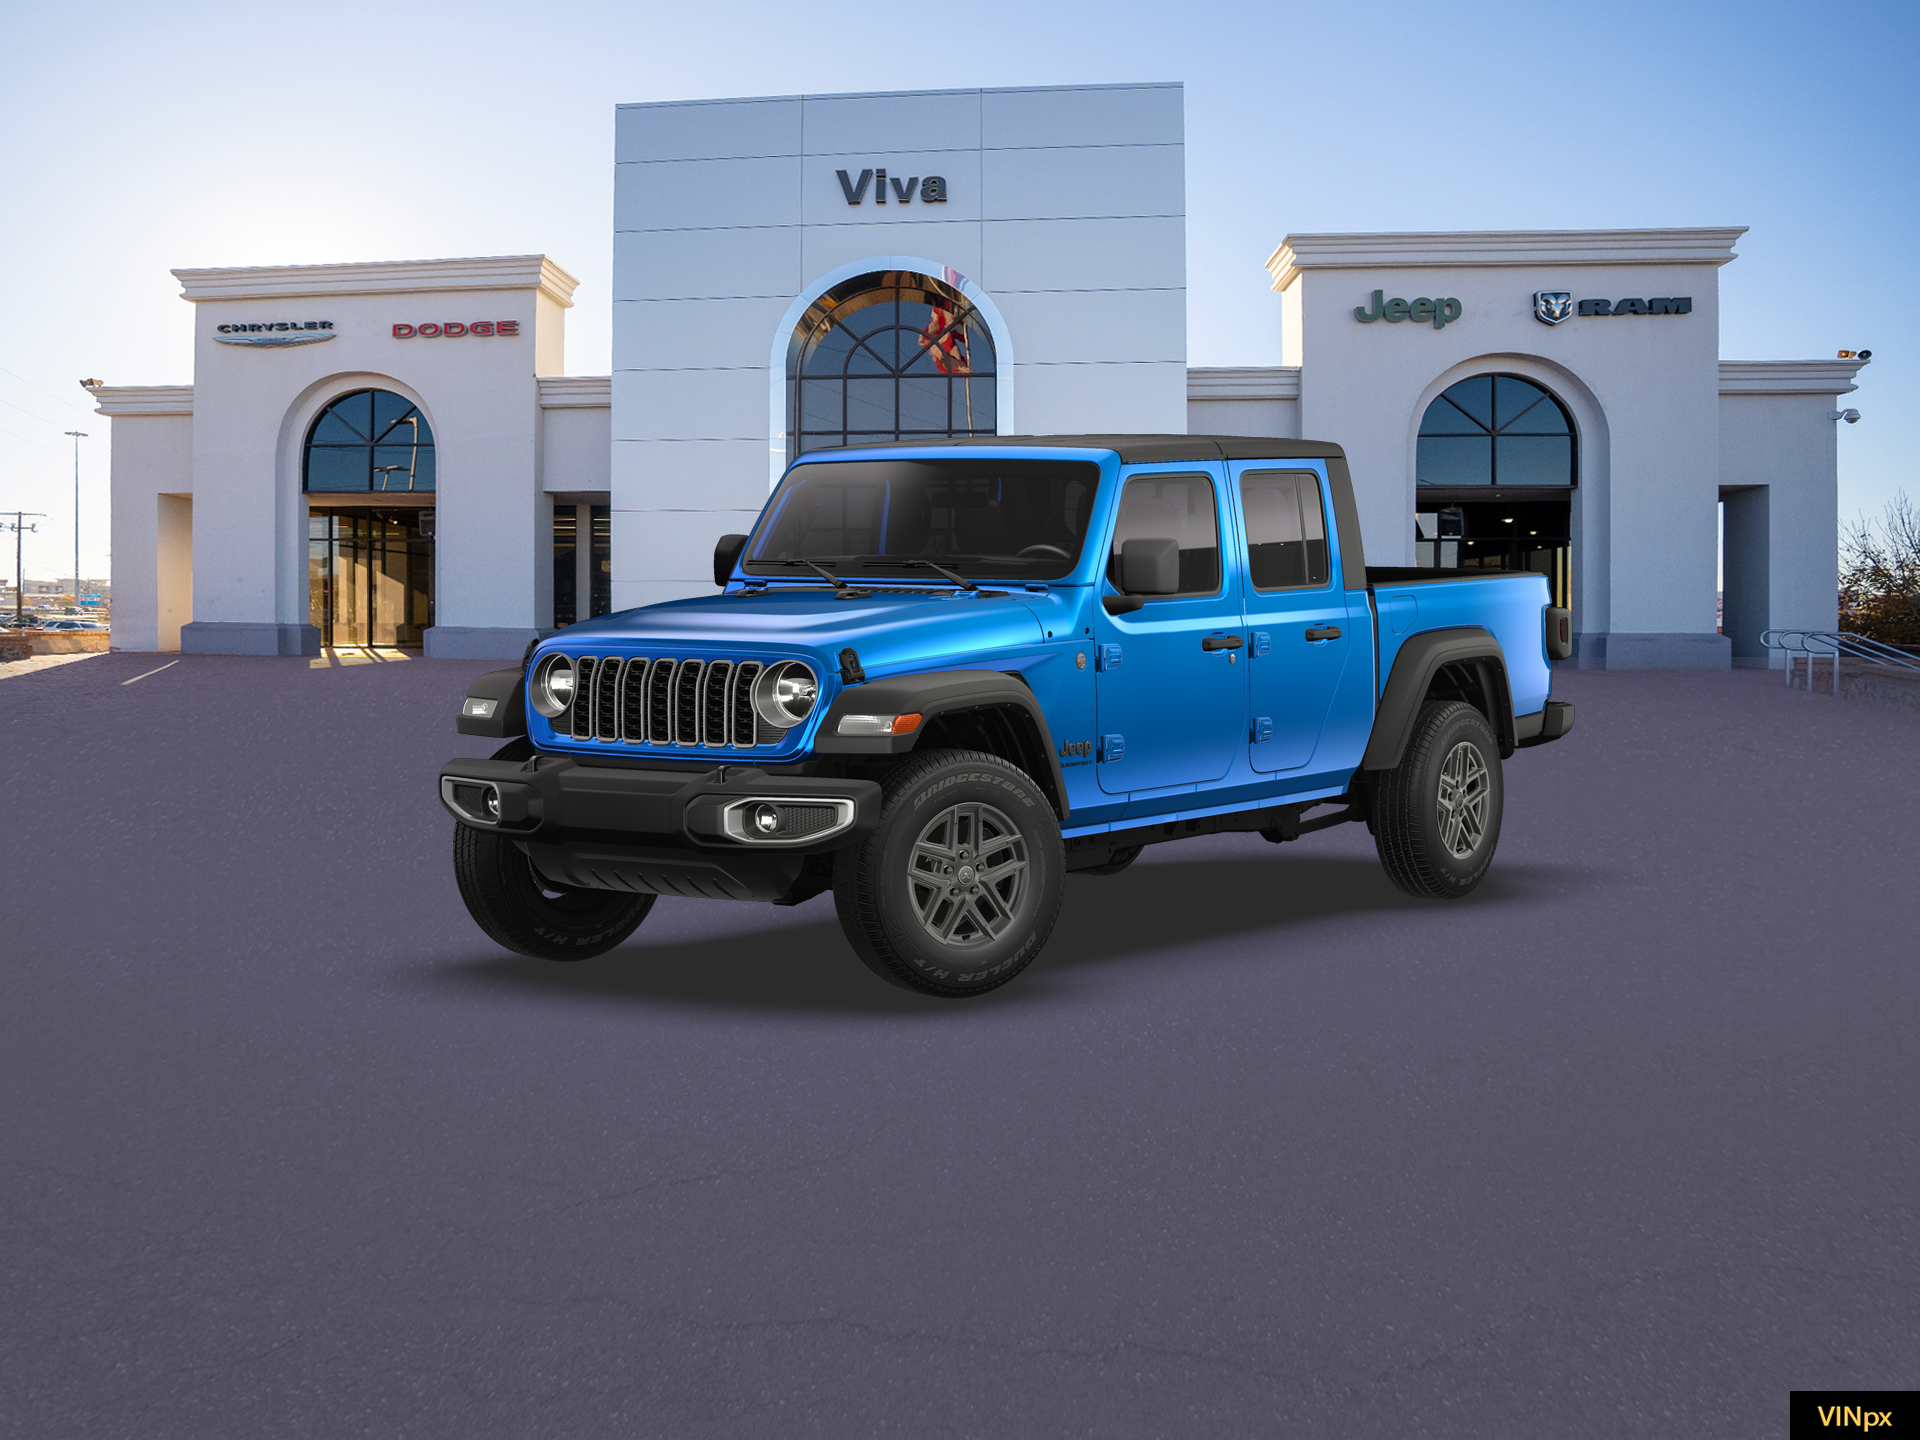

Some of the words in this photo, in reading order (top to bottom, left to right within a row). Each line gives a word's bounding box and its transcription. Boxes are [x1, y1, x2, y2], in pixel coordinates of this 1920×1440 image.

[835, 168, 948, 206] Viva
[1353, 289, 1463, 329] Jeep
[1578, 296, 1693, 317] RAM
[216, 320, 335, 335] CHRYSLER
[391, 319, 520, 339] DODGE
[1441, 718, 1494, 749] BRIDGESTONE
[1058, 738, 1092, 758] Jeep
[913, 772, 1036, 812] BRIDGESTONE
[912, 958, 951, 979] H/T
[957, 929, 1037, 982] DUELER
